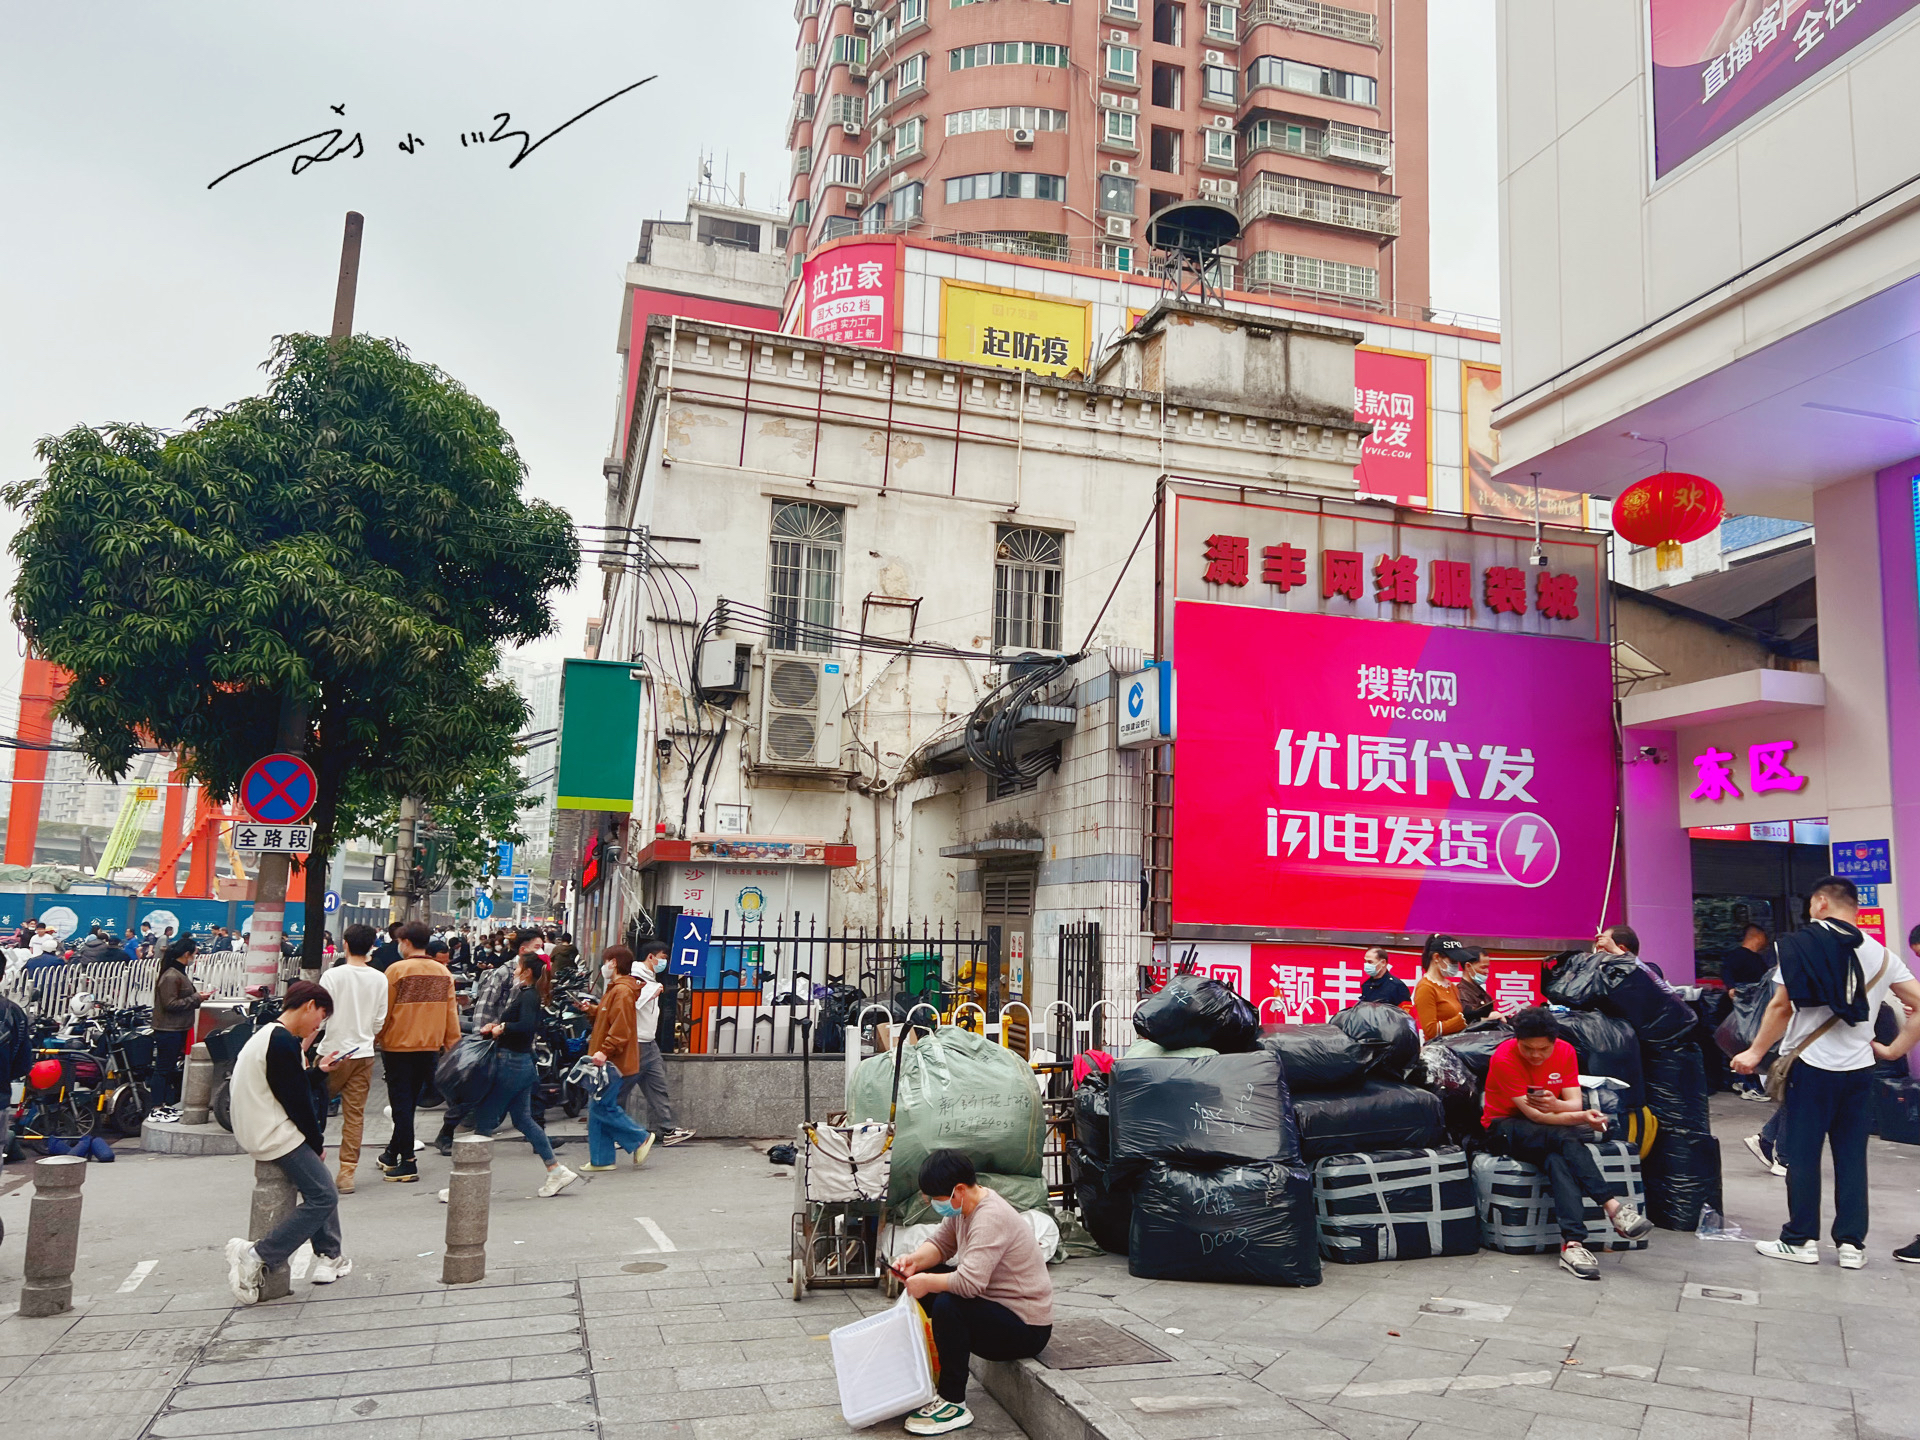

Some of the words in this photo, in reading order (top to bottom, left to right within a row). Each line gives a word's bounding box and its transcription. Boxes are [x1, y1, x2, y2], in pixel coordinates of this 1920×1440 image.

[812, 260, 883, 303] 拉拉家
[841, 317, 876, 329] 实力工厂
[982, 326, 1069, 366] 起防疫
[1202, 533, 1579, 620] 灏丰网络服装城
[1356, 663, 1458, 707] 搜款网
[1369, 704, 1447, 723] VVIC.COM
[1274, 728, 1538, 804] 优质代发
[1689, 740, 1804, 800] 东区
[239, 828, 308, 848] 全路段
[1266, 807, 1489, 870] 闪电发货
[91, 917, 116, 927] 公正
[680, 921, 702, 967] 入口
